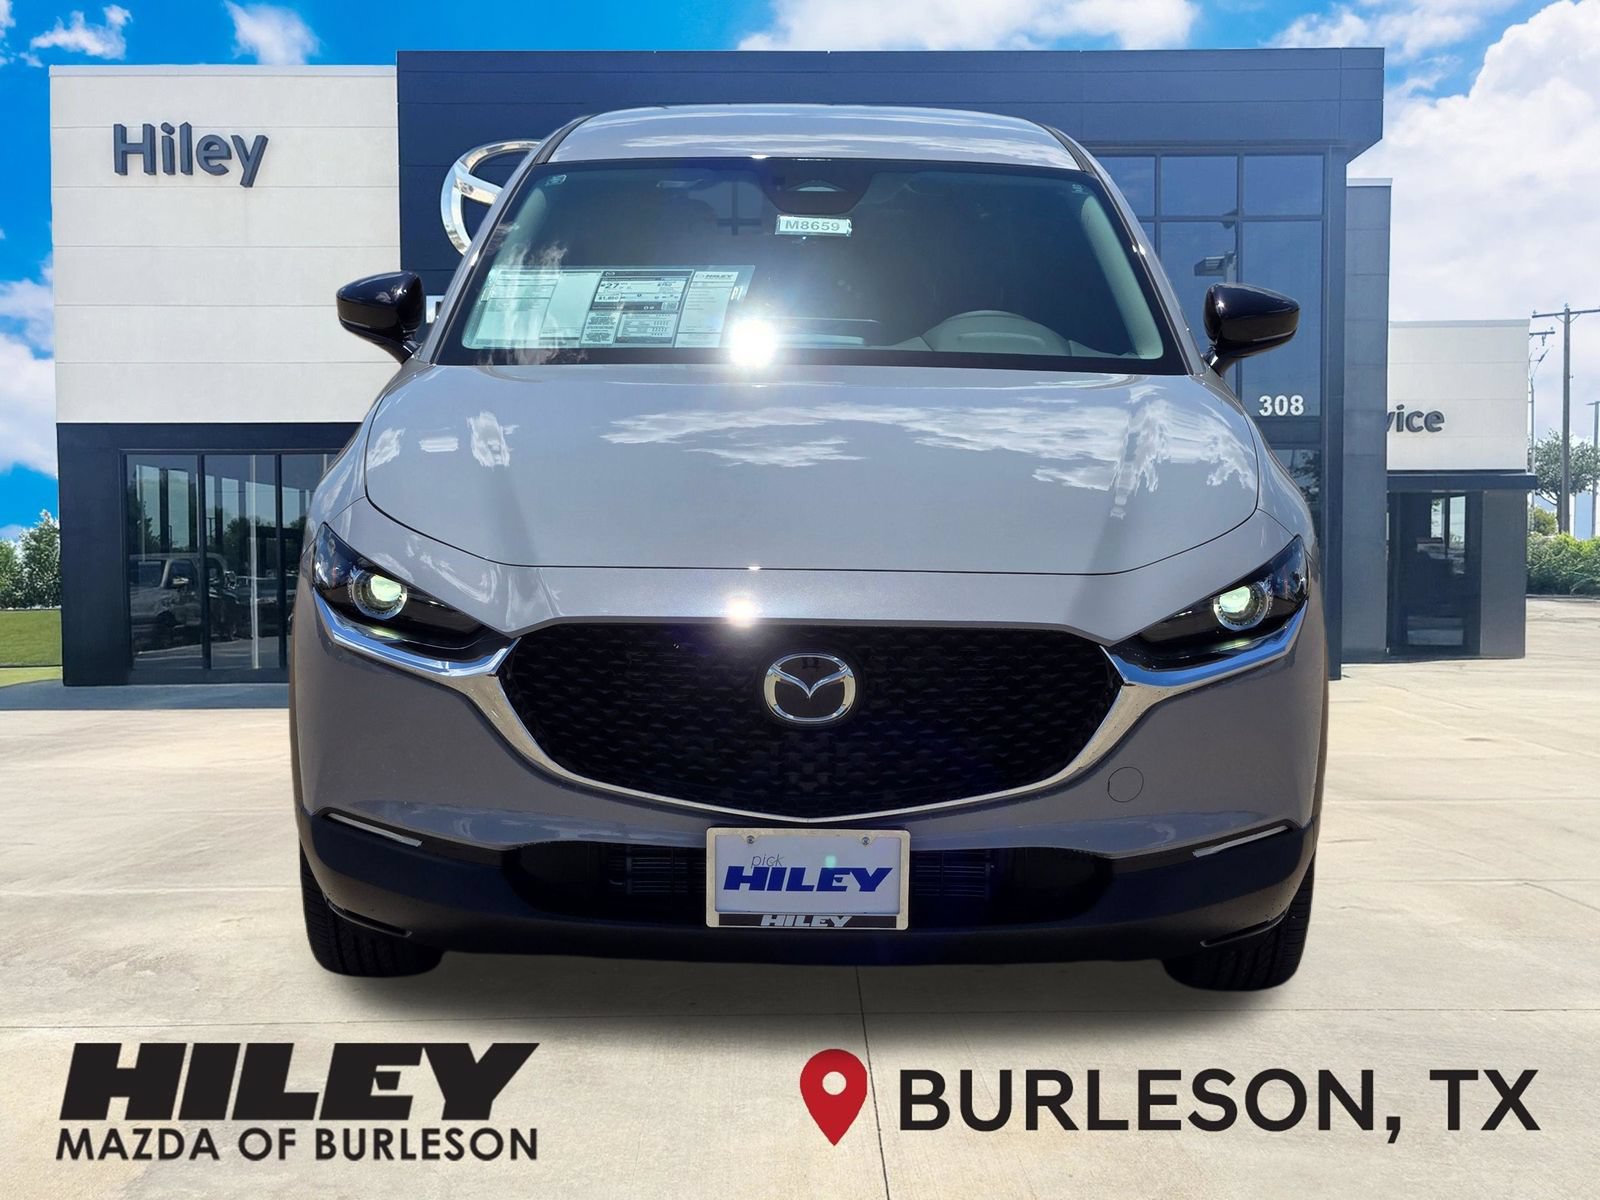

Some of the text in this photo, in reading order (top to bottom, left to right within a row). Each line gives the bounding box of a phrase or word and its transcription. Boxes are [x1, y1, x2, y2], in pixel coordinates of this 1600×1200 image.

[113, 121, 269, 188] Hiley
[784, 218, 841, 231] M8659
[1258, 394, 1305, 417] 308
[751, 854, 784, 868] pick
[723, 865, 893, 893] HILEY
[760, 914, 853, 928] HILEY
